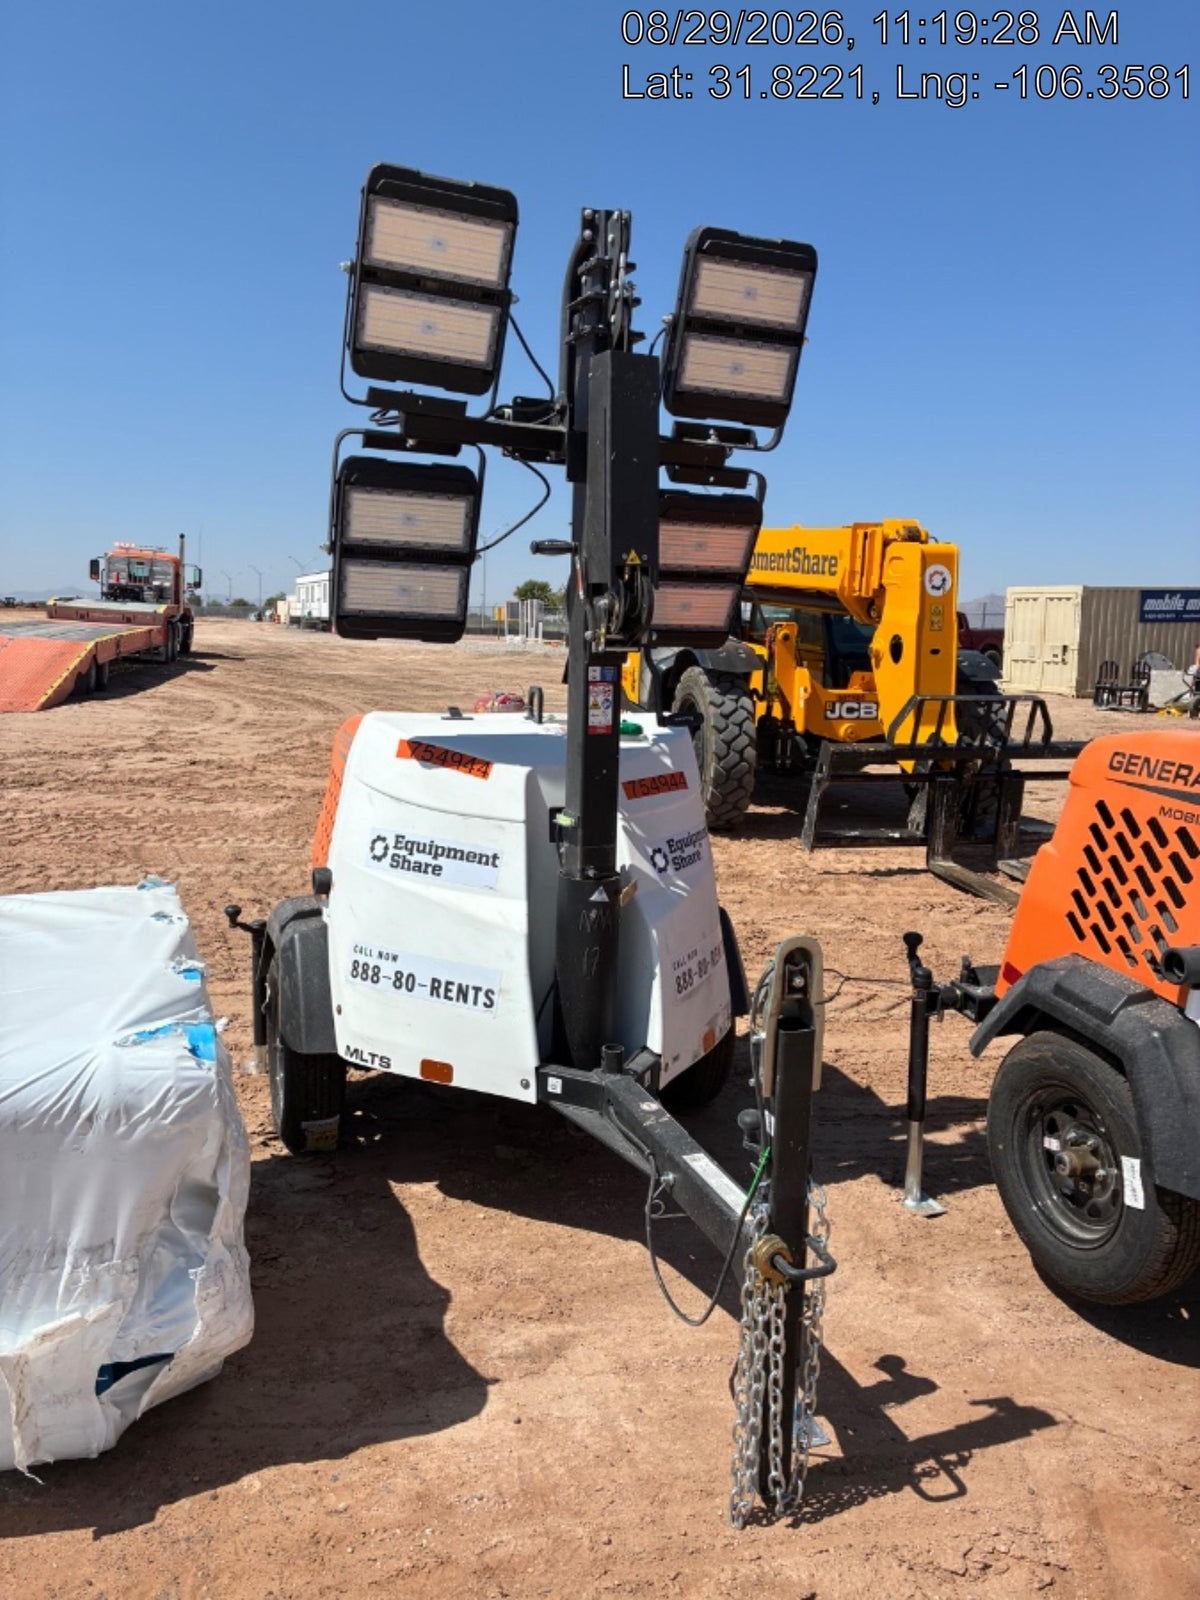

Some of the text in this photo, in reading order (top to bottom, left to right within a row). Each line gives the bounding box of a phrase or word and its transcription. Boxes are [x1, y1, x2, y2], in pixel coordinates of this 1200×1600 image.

[826, 701, 878, 719] JCB
[409, 741, 490, 778] 754944
[392, 834, 501, 868] Equipment
[389, 853, 444, 877] Share
[353, 944, 399, 963] CALL NOW
[350, 959, 496, 1008] 888-80-RENTS
[345, 1045, 392, 1069] MLTS
